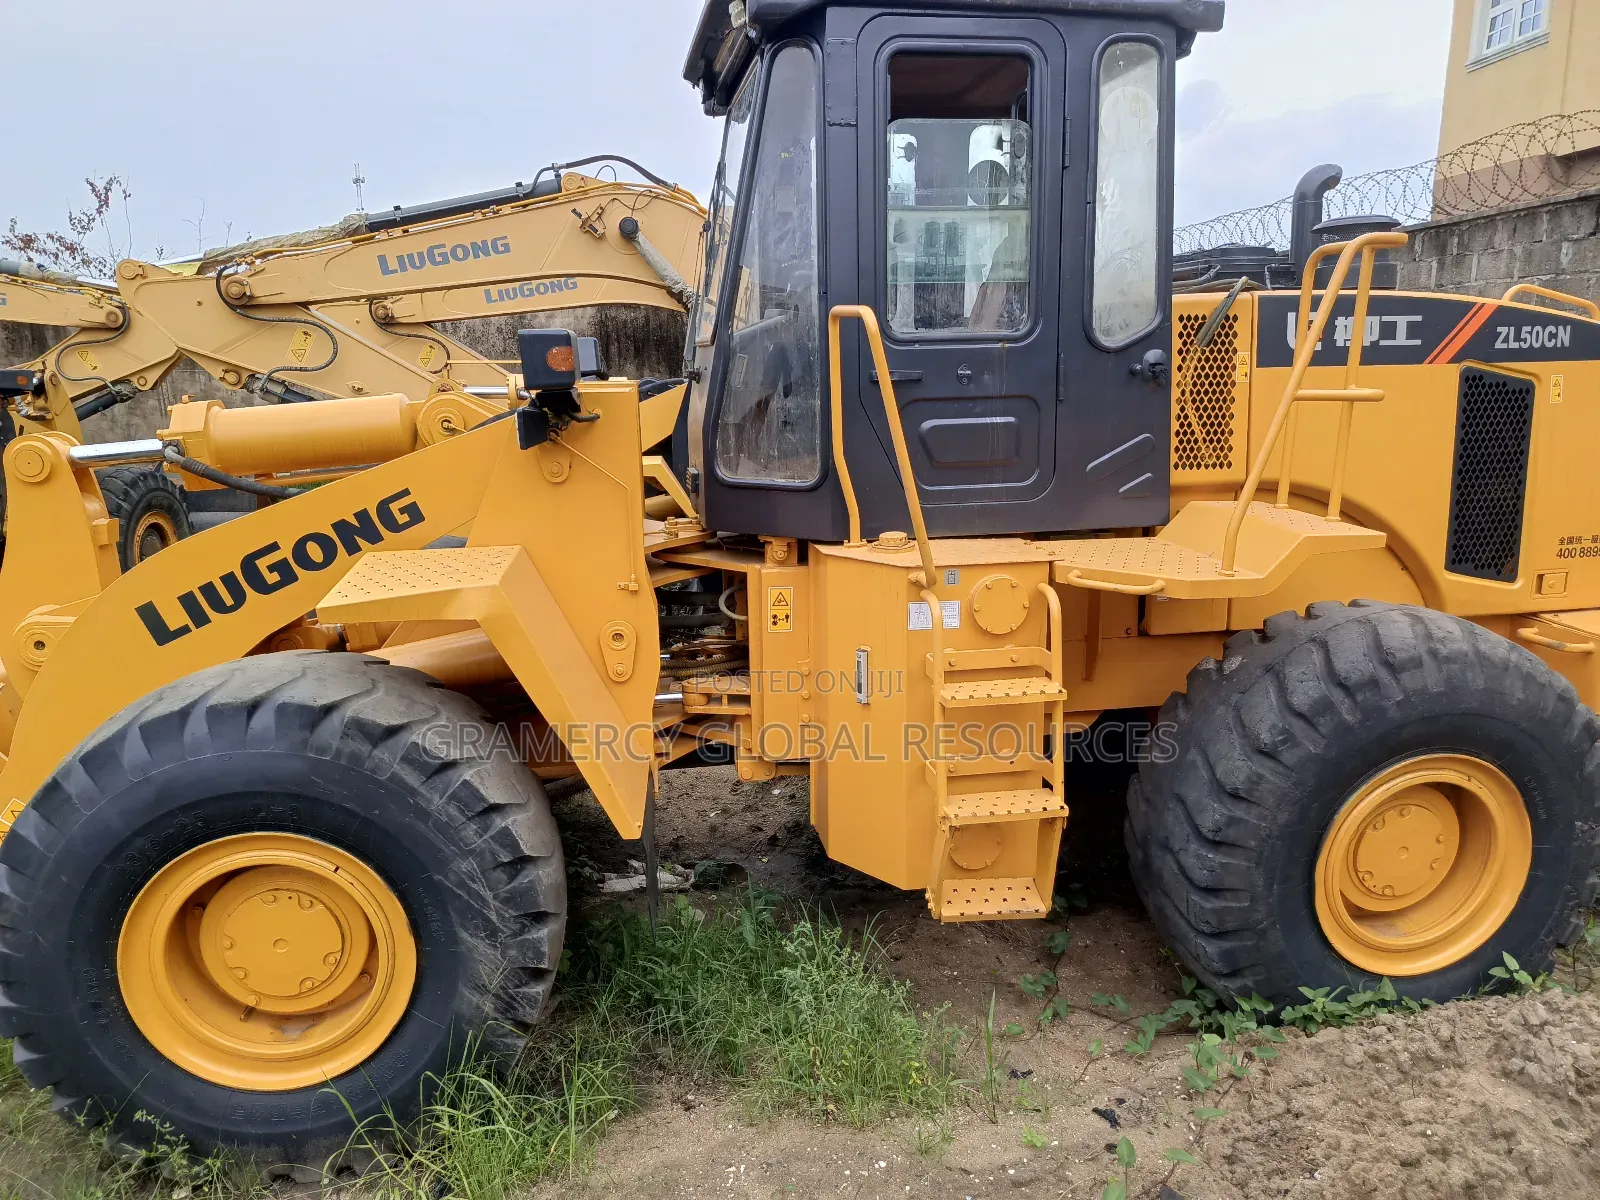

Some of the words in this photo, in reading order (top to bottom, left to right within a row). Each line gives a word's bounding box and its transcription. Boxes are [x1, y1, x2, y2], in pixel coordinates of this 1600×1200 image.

[1494, 325, 1572, 349] ZL50CN
[1557, 534, 1600, 546] 全国统一服
[1556, 547, 1577, 559] 400
[1578, 546, 1600, 558] 889
